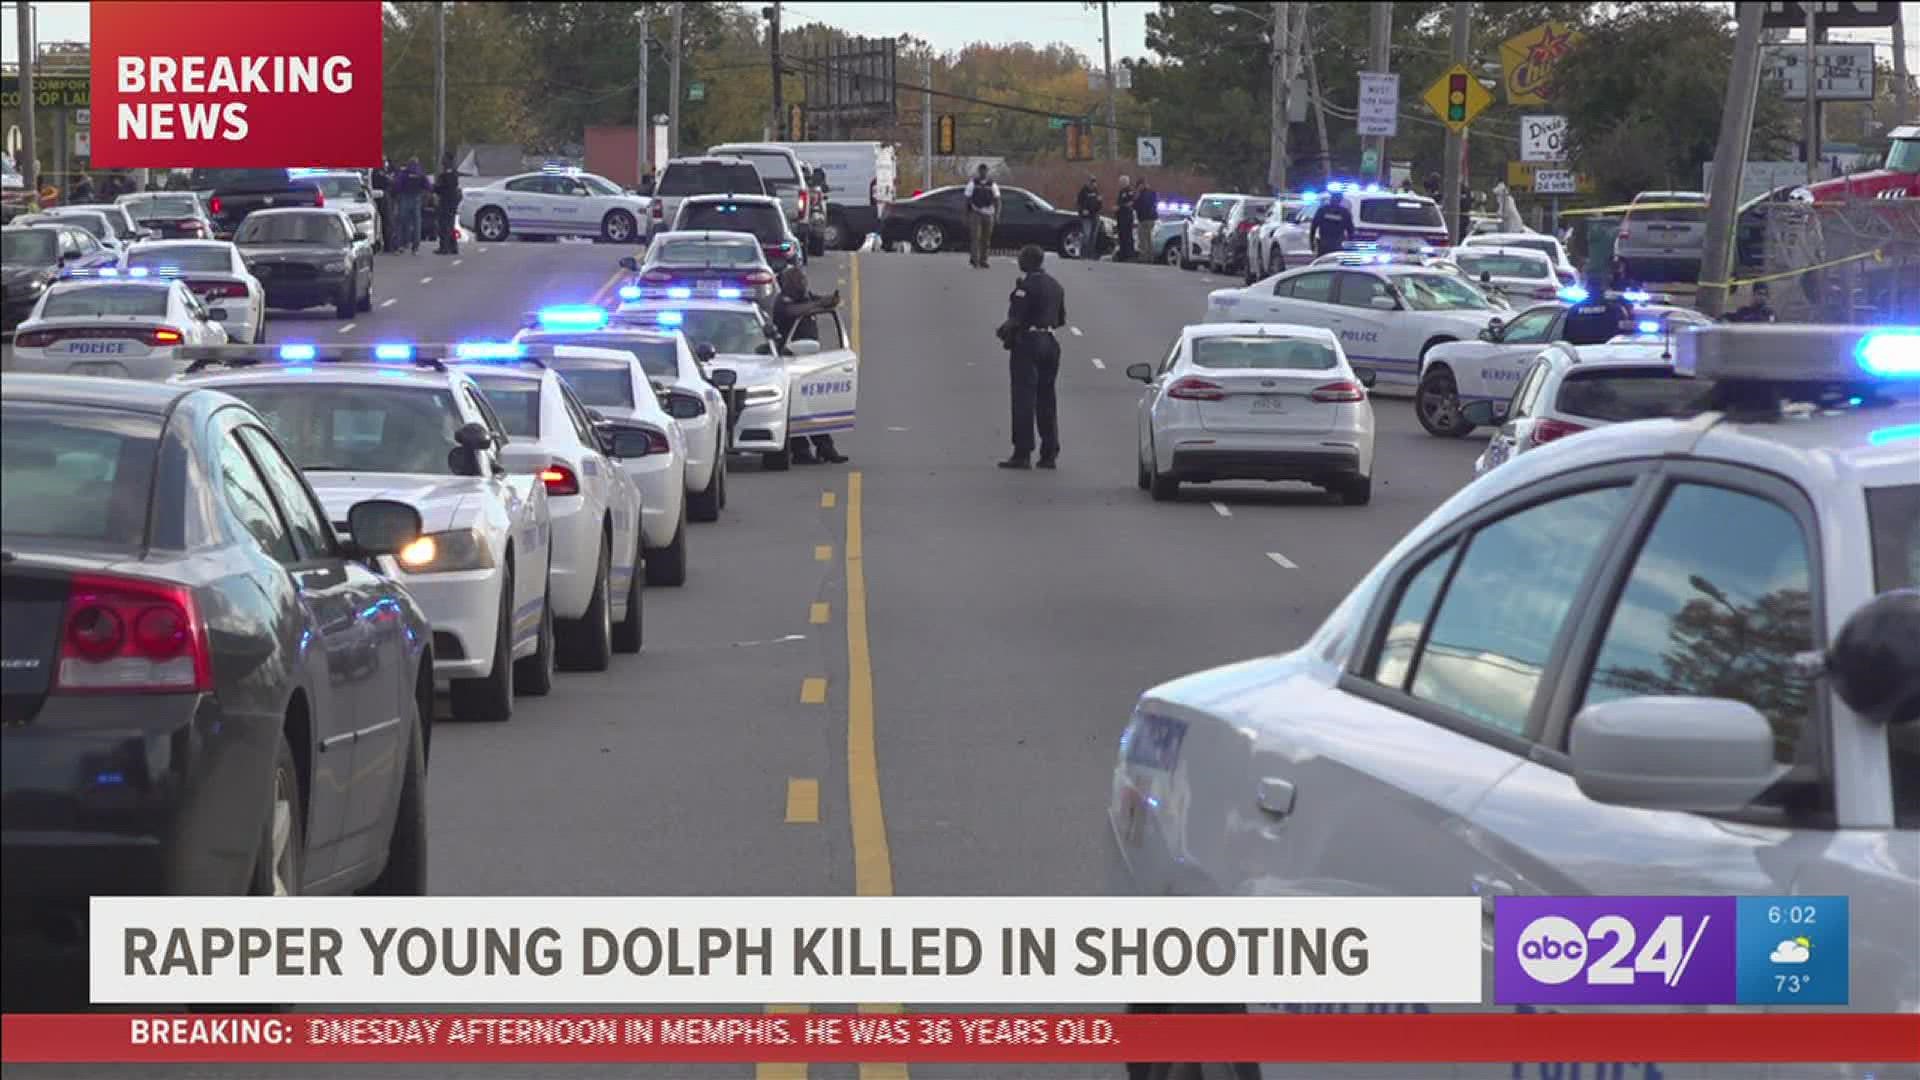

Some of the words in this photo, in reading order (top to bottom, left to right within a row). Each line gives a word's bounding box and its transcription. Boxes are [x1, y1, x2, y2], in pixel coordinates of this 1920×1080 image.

[1340, 329, 1378, 342] POLICE
[69, 342, 125, 354] POLICE
[801, 380, 852, 396] MEMPHIS
